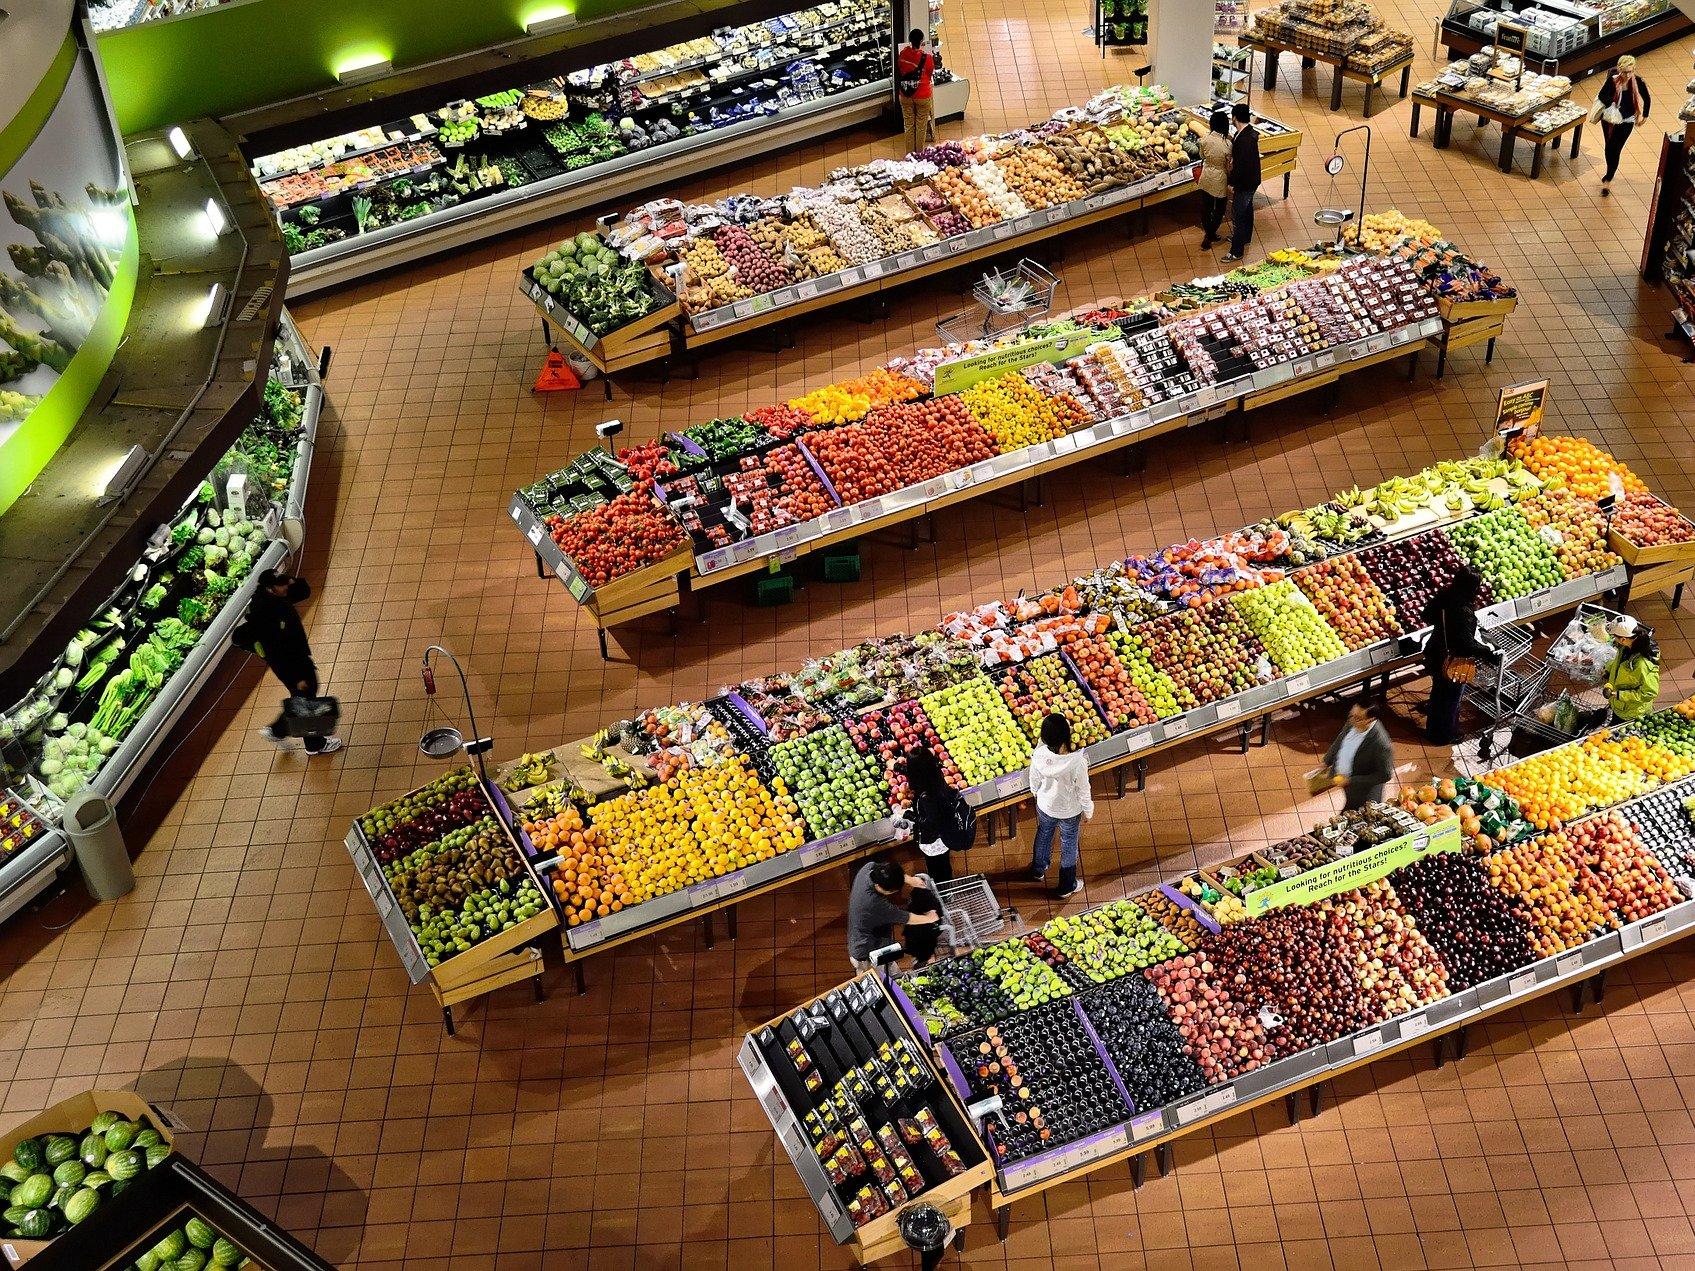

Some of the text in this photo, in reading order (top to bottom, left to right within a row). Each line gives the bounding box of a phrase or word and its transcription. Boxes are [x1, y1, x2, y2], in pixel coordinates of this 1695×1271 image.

[963, 359, 987, 369] Looking
[998, 350, 1026, 361] nutritious
[1028, 341, 1052, 353] choices?
[979, 362, 997, 371] Reach
[1019, 351, 1037, 361] Stars!
[1285, 841, 1408, 893] Looking for nutritious choices?
[1308, 857, 1387, 893] Reach for the Stars!
